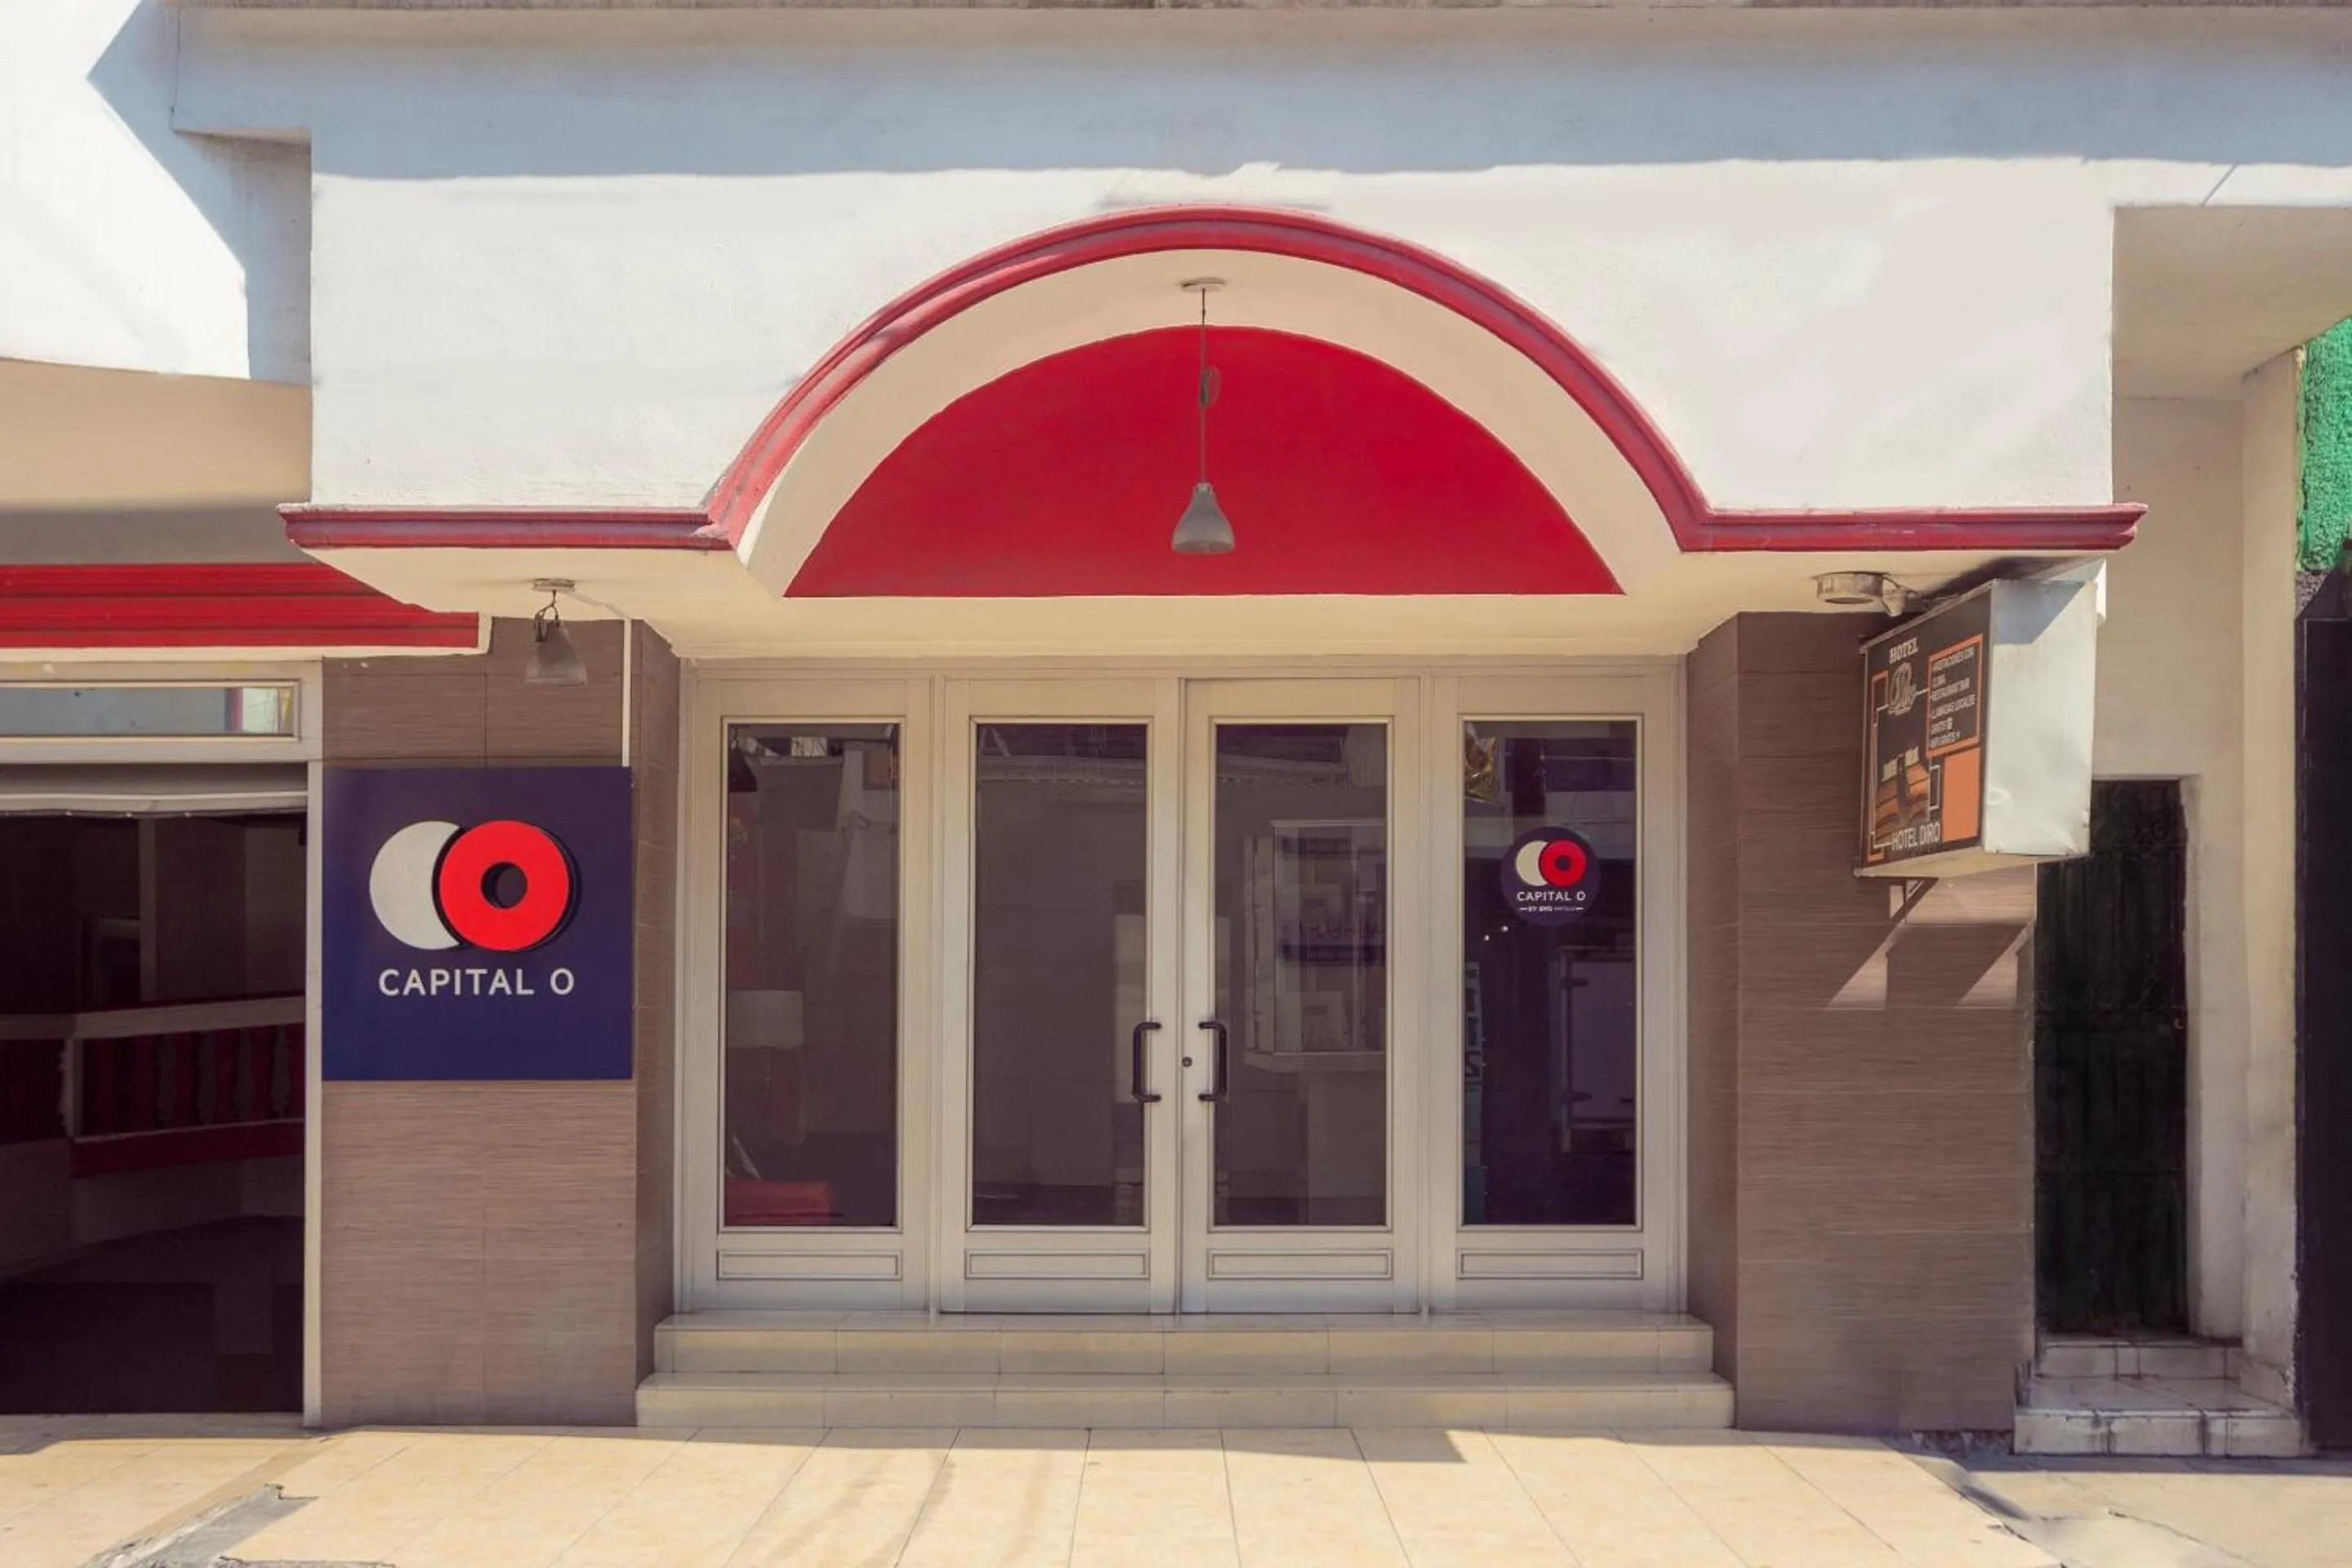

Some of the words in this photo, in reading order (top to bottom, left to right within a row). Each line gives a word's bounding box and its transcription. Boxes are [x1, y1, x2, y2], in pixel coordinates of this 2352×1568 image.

[1889, 637, 1919, 665] HOTEL
[1891, 826, 1918, 851] HOTEL
[1517, 891, 1572, 902] CAPITAL
[1576, 890, 1586, 902] O
[378, 968, 535, 996] CAPITAL
[550, 968, 575, 996] O
